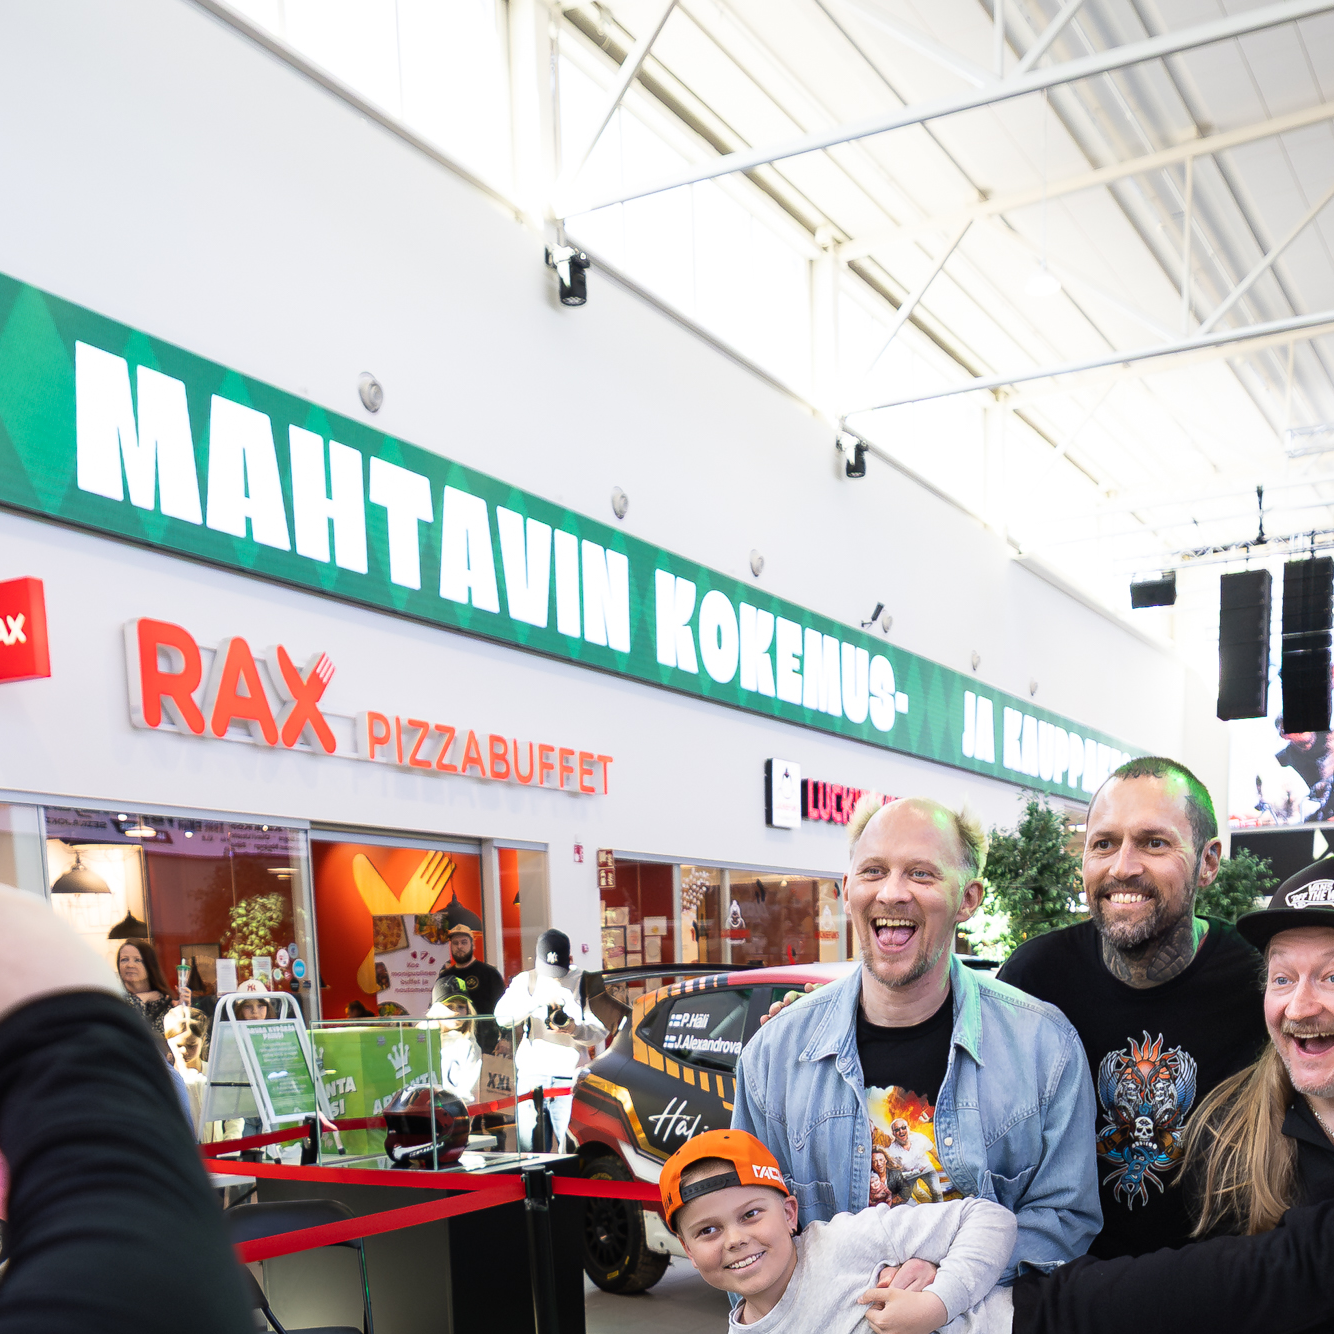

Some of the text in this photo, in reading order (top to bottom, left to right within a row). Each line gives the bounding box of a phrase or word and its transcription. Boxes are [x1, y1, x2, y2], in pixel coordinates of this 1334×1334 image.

[75, 340, 1132, 795] MAHTAVIN KOKEMUS- JA KAUPPAK
[135, 616, 614, 796] RAX PIZZABUFFET
[1308, 882, 1334, 892] VANS
[681, 1012, 710, 1030] P.Häli
[674, 1035, 742, 1055] J.Alexandrova
[487, 1071, 512, 1092] XXL
